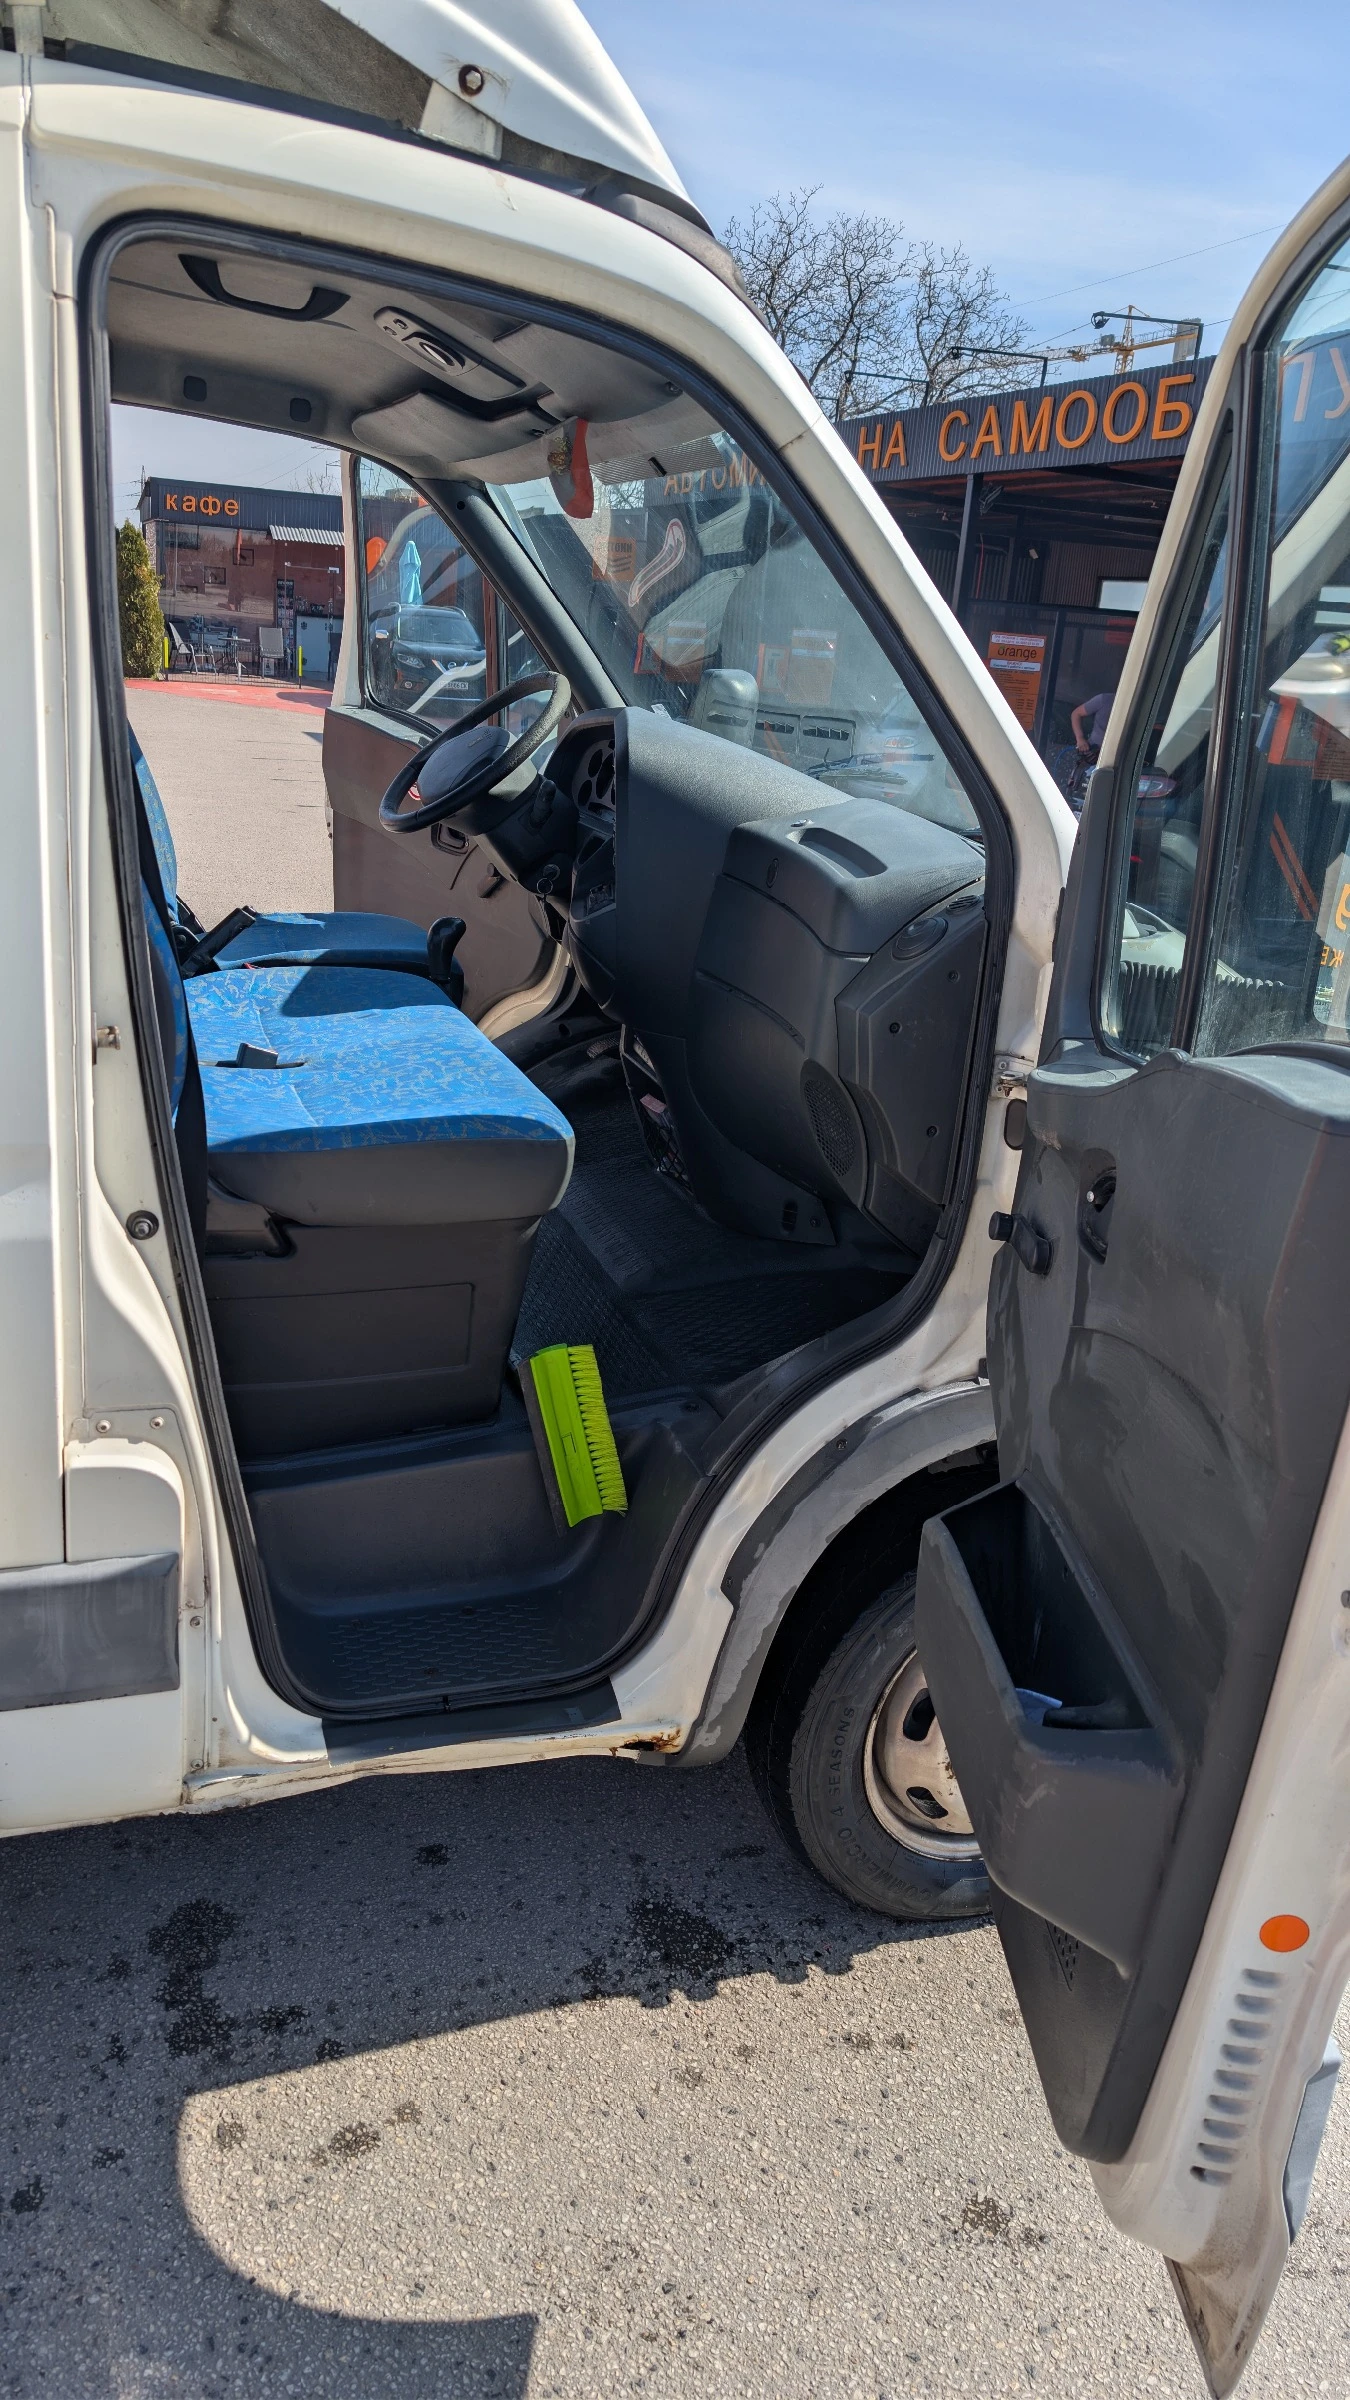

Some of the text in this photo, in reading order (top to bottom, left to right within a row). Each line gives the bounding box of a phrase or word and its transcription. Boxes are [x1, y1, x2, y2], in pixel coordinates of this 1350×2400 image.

[857, 420, 908, 470] НА
[165, 492, 239, 516] кафе
[997, 646, 1037, 661] orange
[828, 1706, 855, 1797] SEASONS
[831, 1804, 846, 1817] 4
